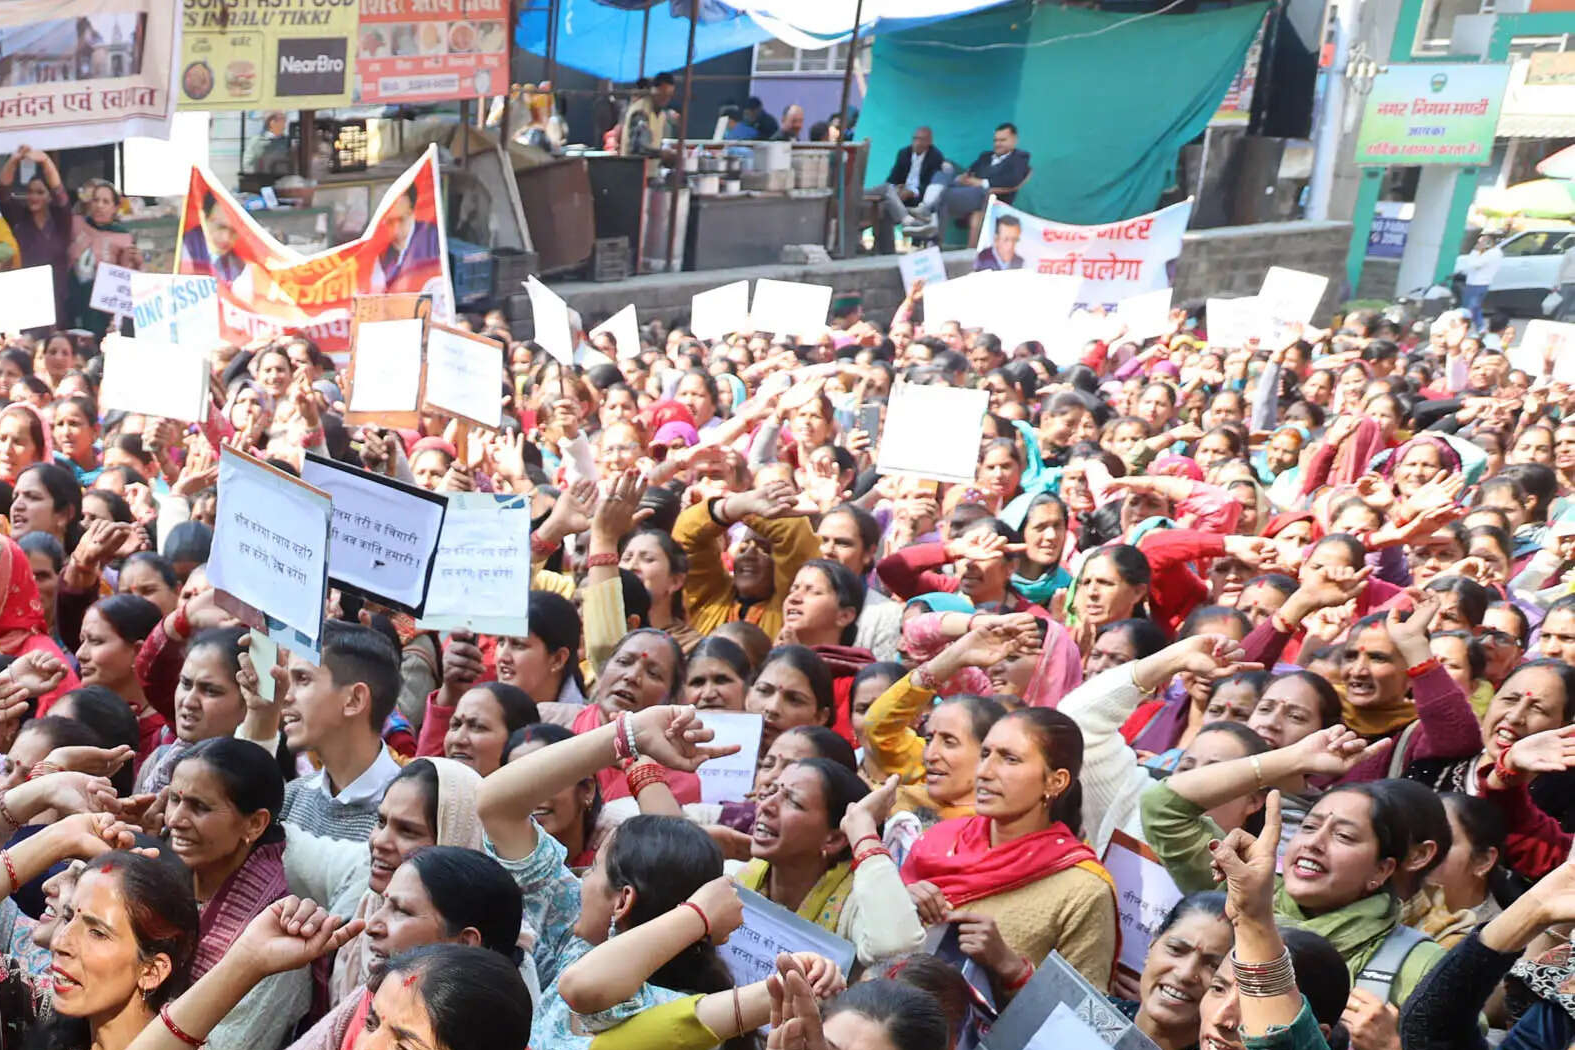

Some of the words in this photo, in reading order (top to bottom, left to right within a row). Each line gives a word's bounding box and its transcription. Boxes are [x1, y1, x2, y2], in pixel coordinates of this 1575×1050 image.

[279, 10, 332, 25] TIKKI
[280, 54, 344, 74] NearBro
[62, 86, 95, 113] एवं
[1037, 251, 1083, 276] नहीं
[1081, 252, 1143, 281] चलेगा
